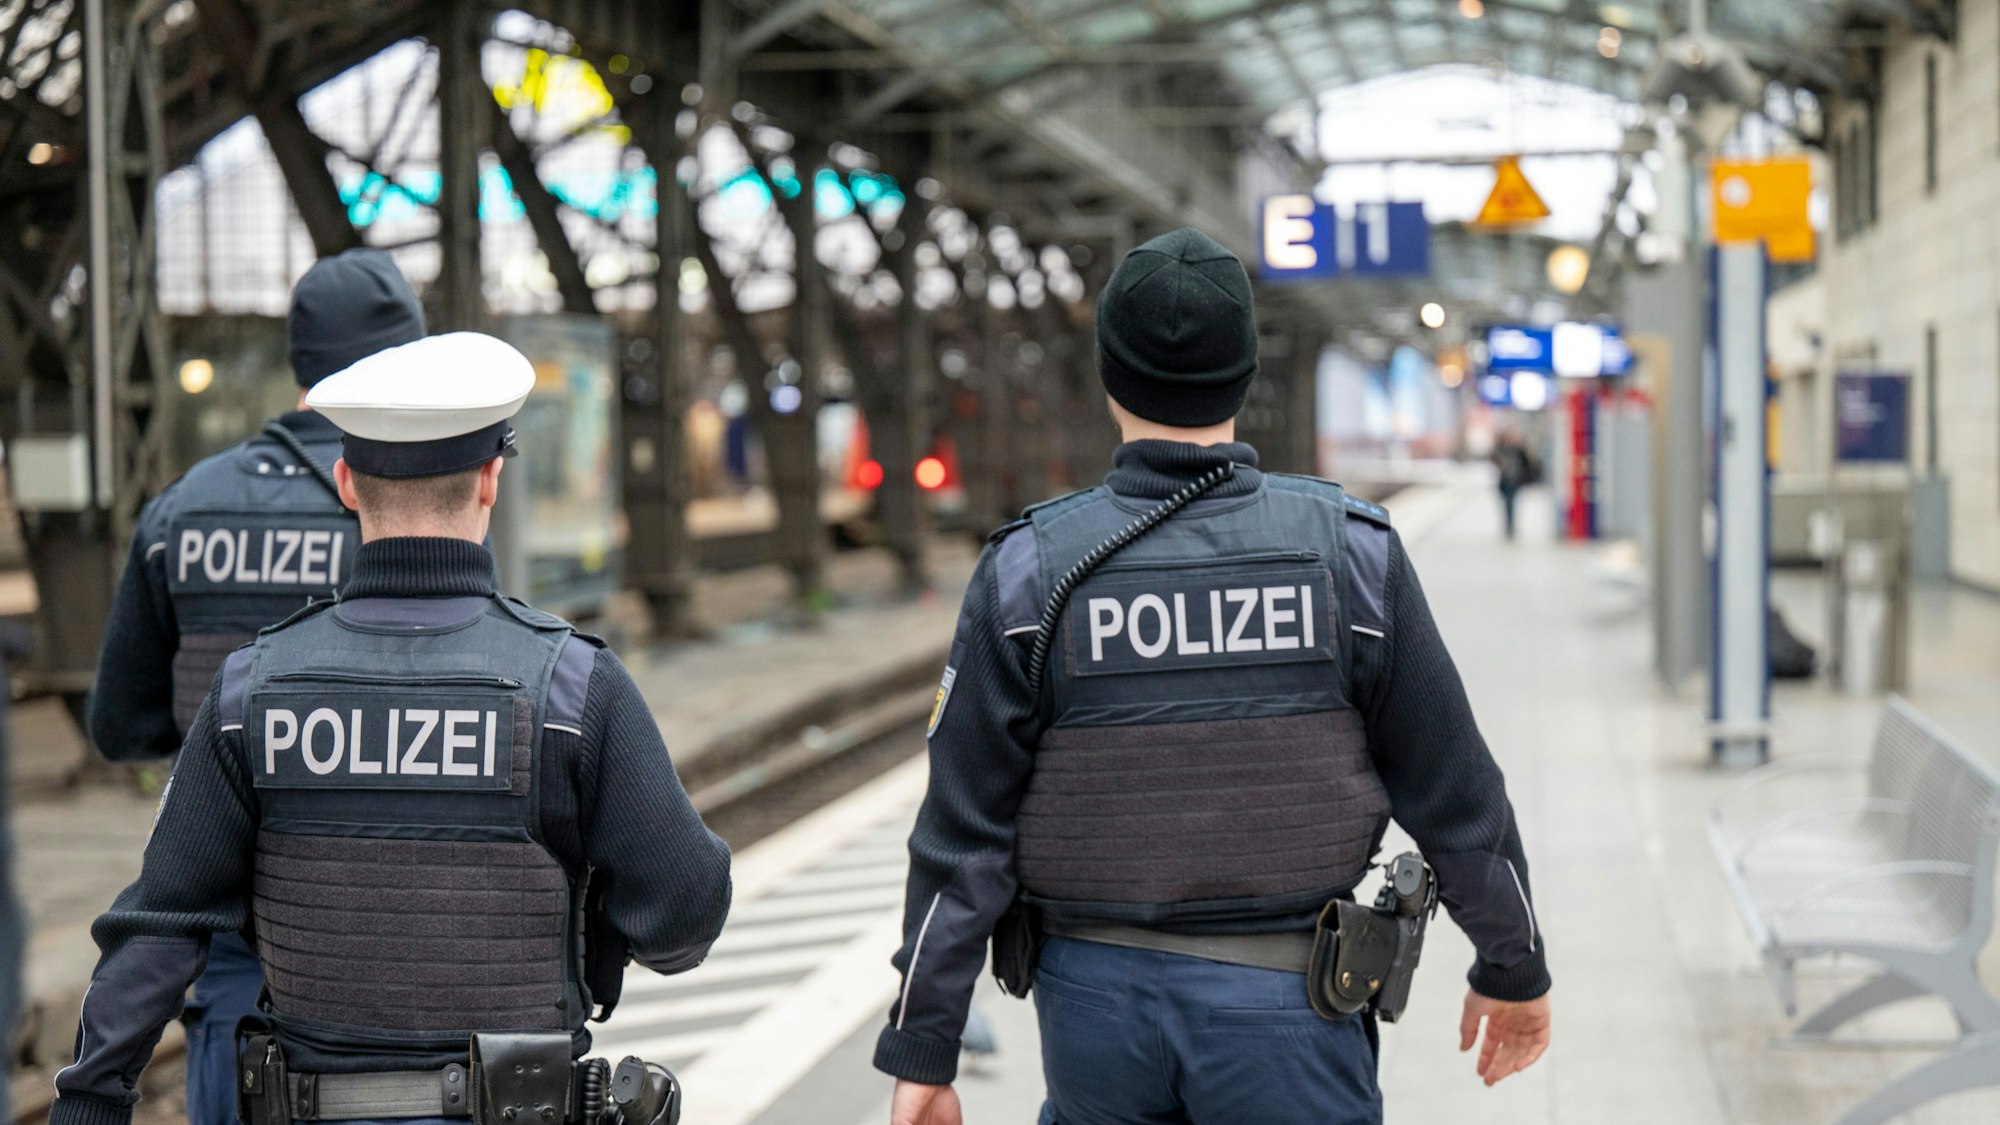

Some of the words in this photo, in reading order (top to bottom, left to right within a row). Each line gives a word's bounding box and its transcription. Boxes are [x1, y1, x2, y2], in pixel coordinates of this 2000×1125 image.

[1264, 194, 1317, 269] E
[178, 528, 344, 585] POLIZEI
[1089, 585, 1315, 662] POLIZEI
[265, 707, 497, 776] POLIZEI
